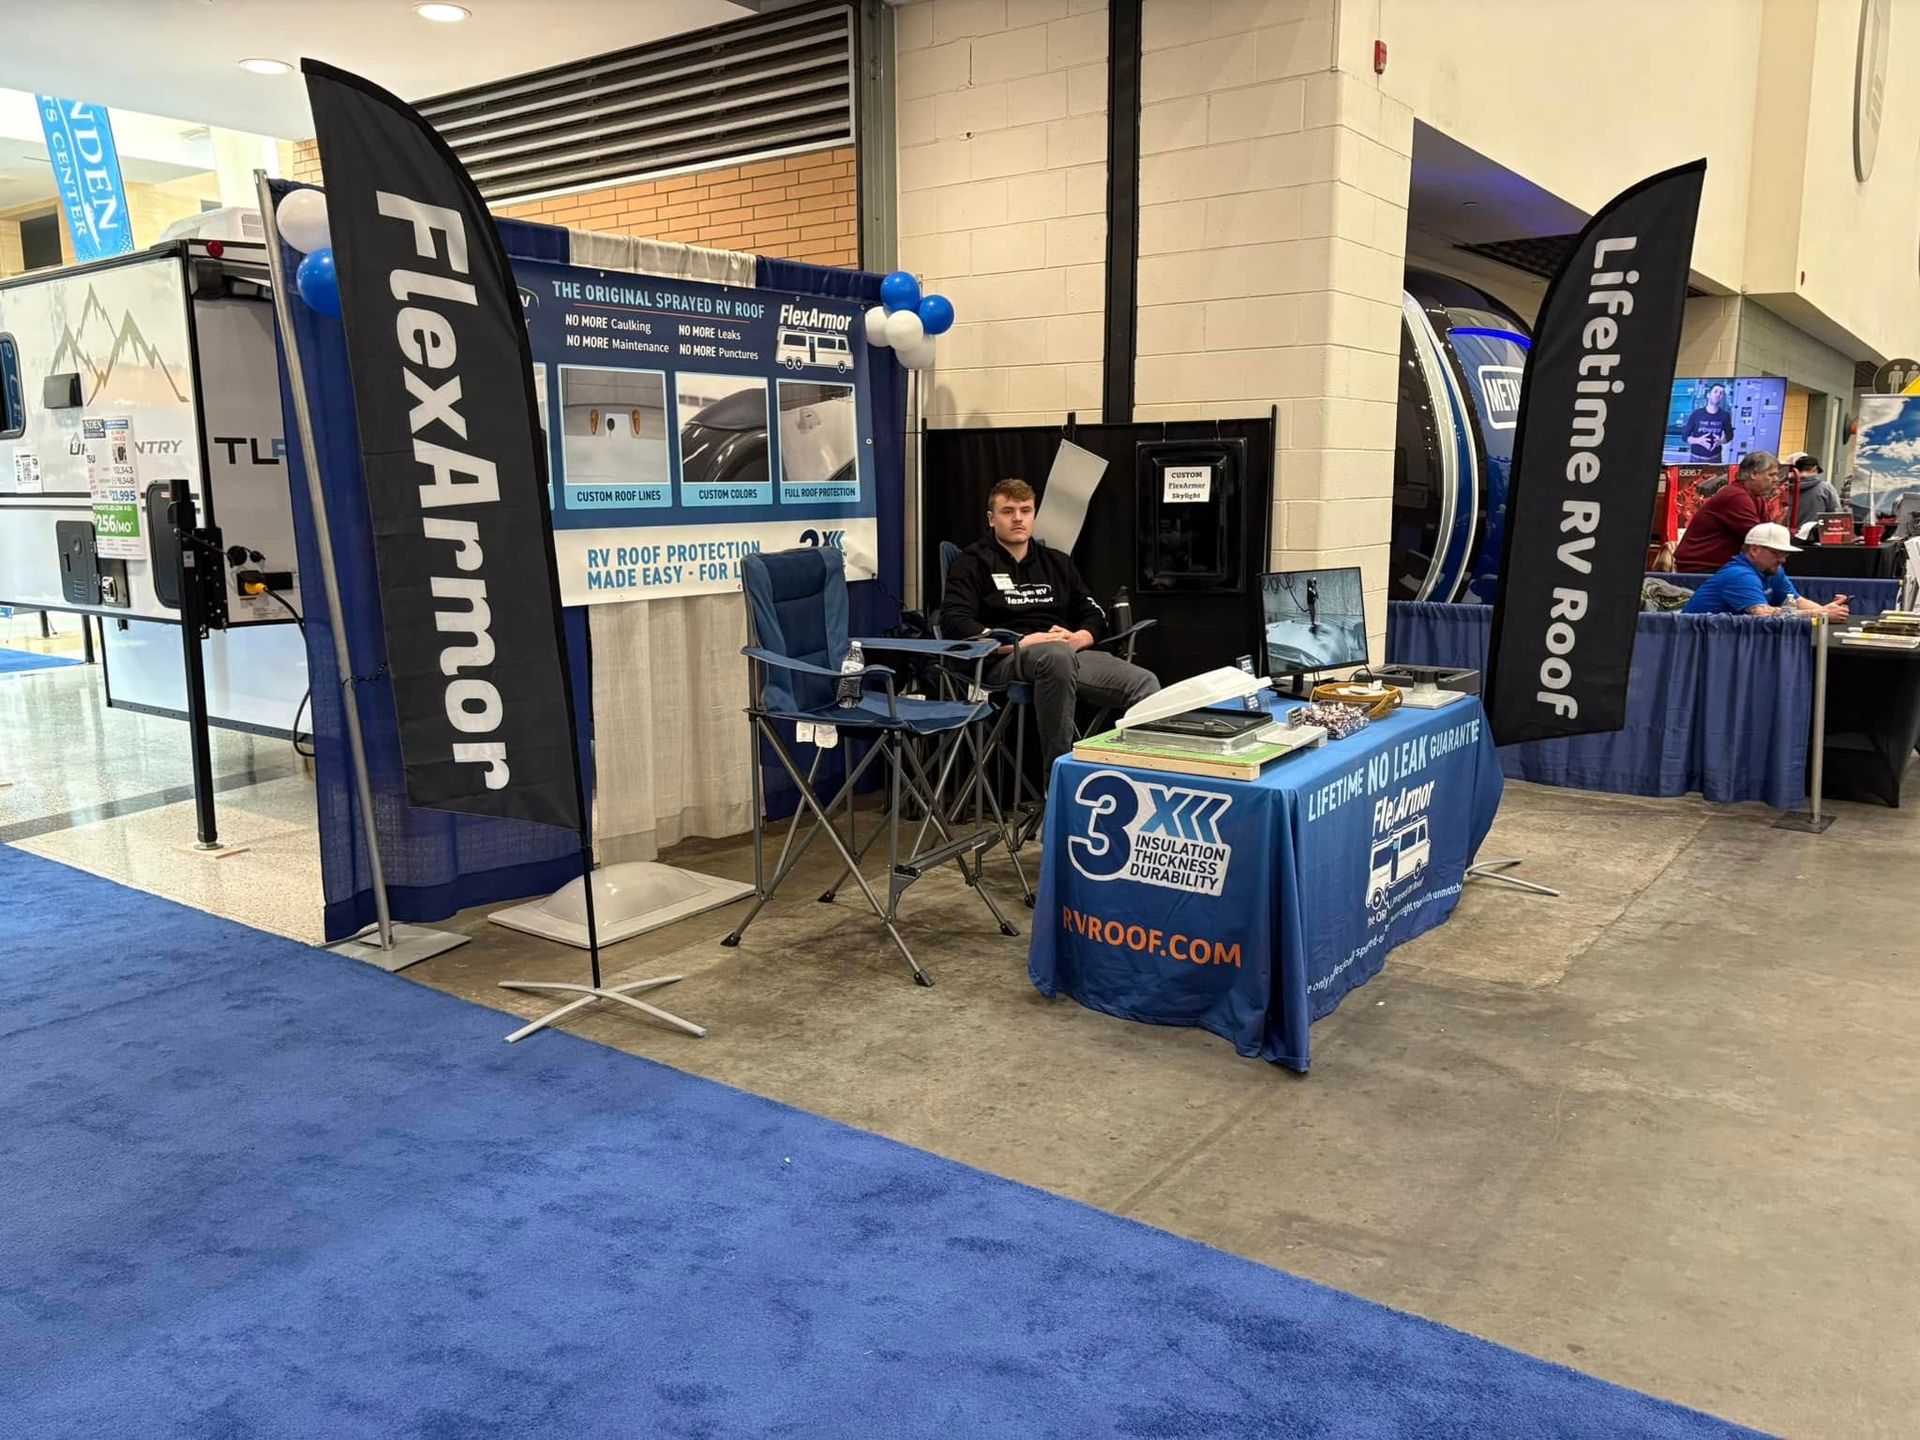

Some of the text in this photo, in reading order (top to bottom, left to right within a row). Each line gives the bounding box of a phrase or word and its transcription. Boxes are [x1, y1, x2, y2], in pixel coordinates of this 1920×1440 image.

[52, 131, 88, 236] CENTER
[552, 281, 765, 319] THE ORIGINAL SPRAYED RV ROOF
[565, 313, 652, 334] NO MORE Caulking
[779, 304, 852, 331] FlexArmor
[566, 335, 670, 353] NO MORE Maintenance
[678, 324, 741, 340] NO MORE Leaks
[679, 343, 759, 360] NO MORE Punctures
[1566, 237, 1640, 484] Lifetime
[376, 190, 510, 790] FlexArmor
[577, 490, 661, 502] CUSTOM ROOF LINES
[699, 489, 757, 500] CUSTOM COLORS
[785, 487, 856, 498] FULL ROOF PROTECTION
[1172, 492, 1201, 500] Skylight
[588, 541, 760, 568] RV ROOF PROTECTION
[588, 570, 637, 590] MADE
[643, 565, 683, 586] EASY
[699, 562, 728, 581] FOR
[1537, 587, 1588, 719] Roof
[1308, 767, 1364, 822] LIFETIME
[1367, 752, 1389, 795] NO
[1393, 735, 1429, 782] LEAK
[1135, 834, 1226, 861] INSULATION
[1134, 849, 1217, 875] THICKNESS
[1130, 864, 1220, 890] DURABILITY
[1063, 906, 1242, 968] RVROOF.COM
[1313, 975, 1329, 991] only
